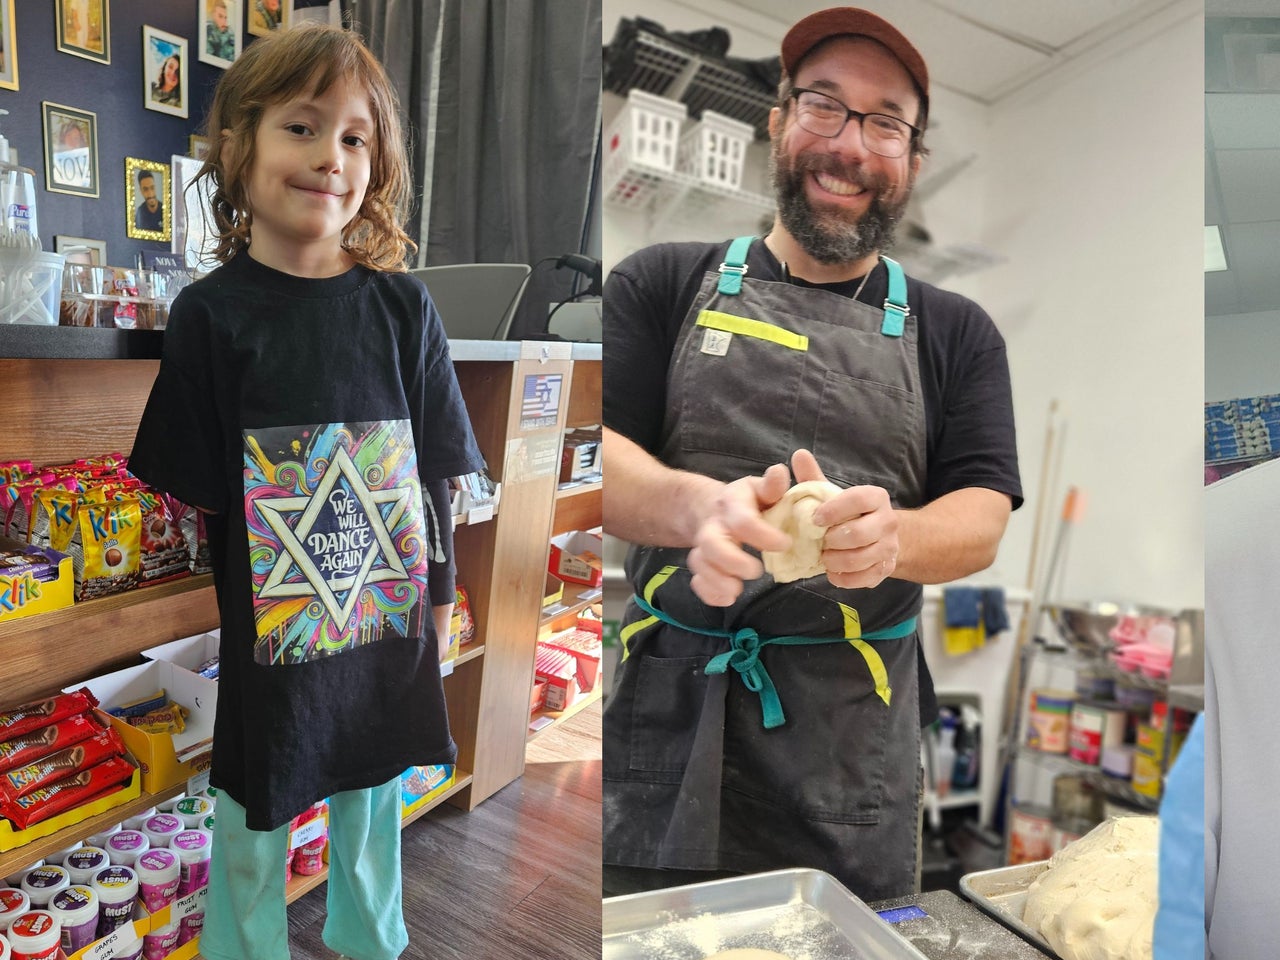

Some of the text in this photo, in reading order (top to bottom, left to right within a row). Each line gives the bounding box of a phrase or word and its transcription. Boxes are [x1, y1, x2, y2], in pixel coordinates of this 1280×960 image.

[329, 491, 356, 515] WE
[338, 513, 368, 530] WILL
[308, 527, 372, 556] DANCE
[320, 549, 364, 574] AGAIN
[105, 902, 134, 918] MUST
[177, 893, 196, 909] FRUIT
[184, 903, 199, 915] GUM
[94, 933, 119, 954] GRAPES
